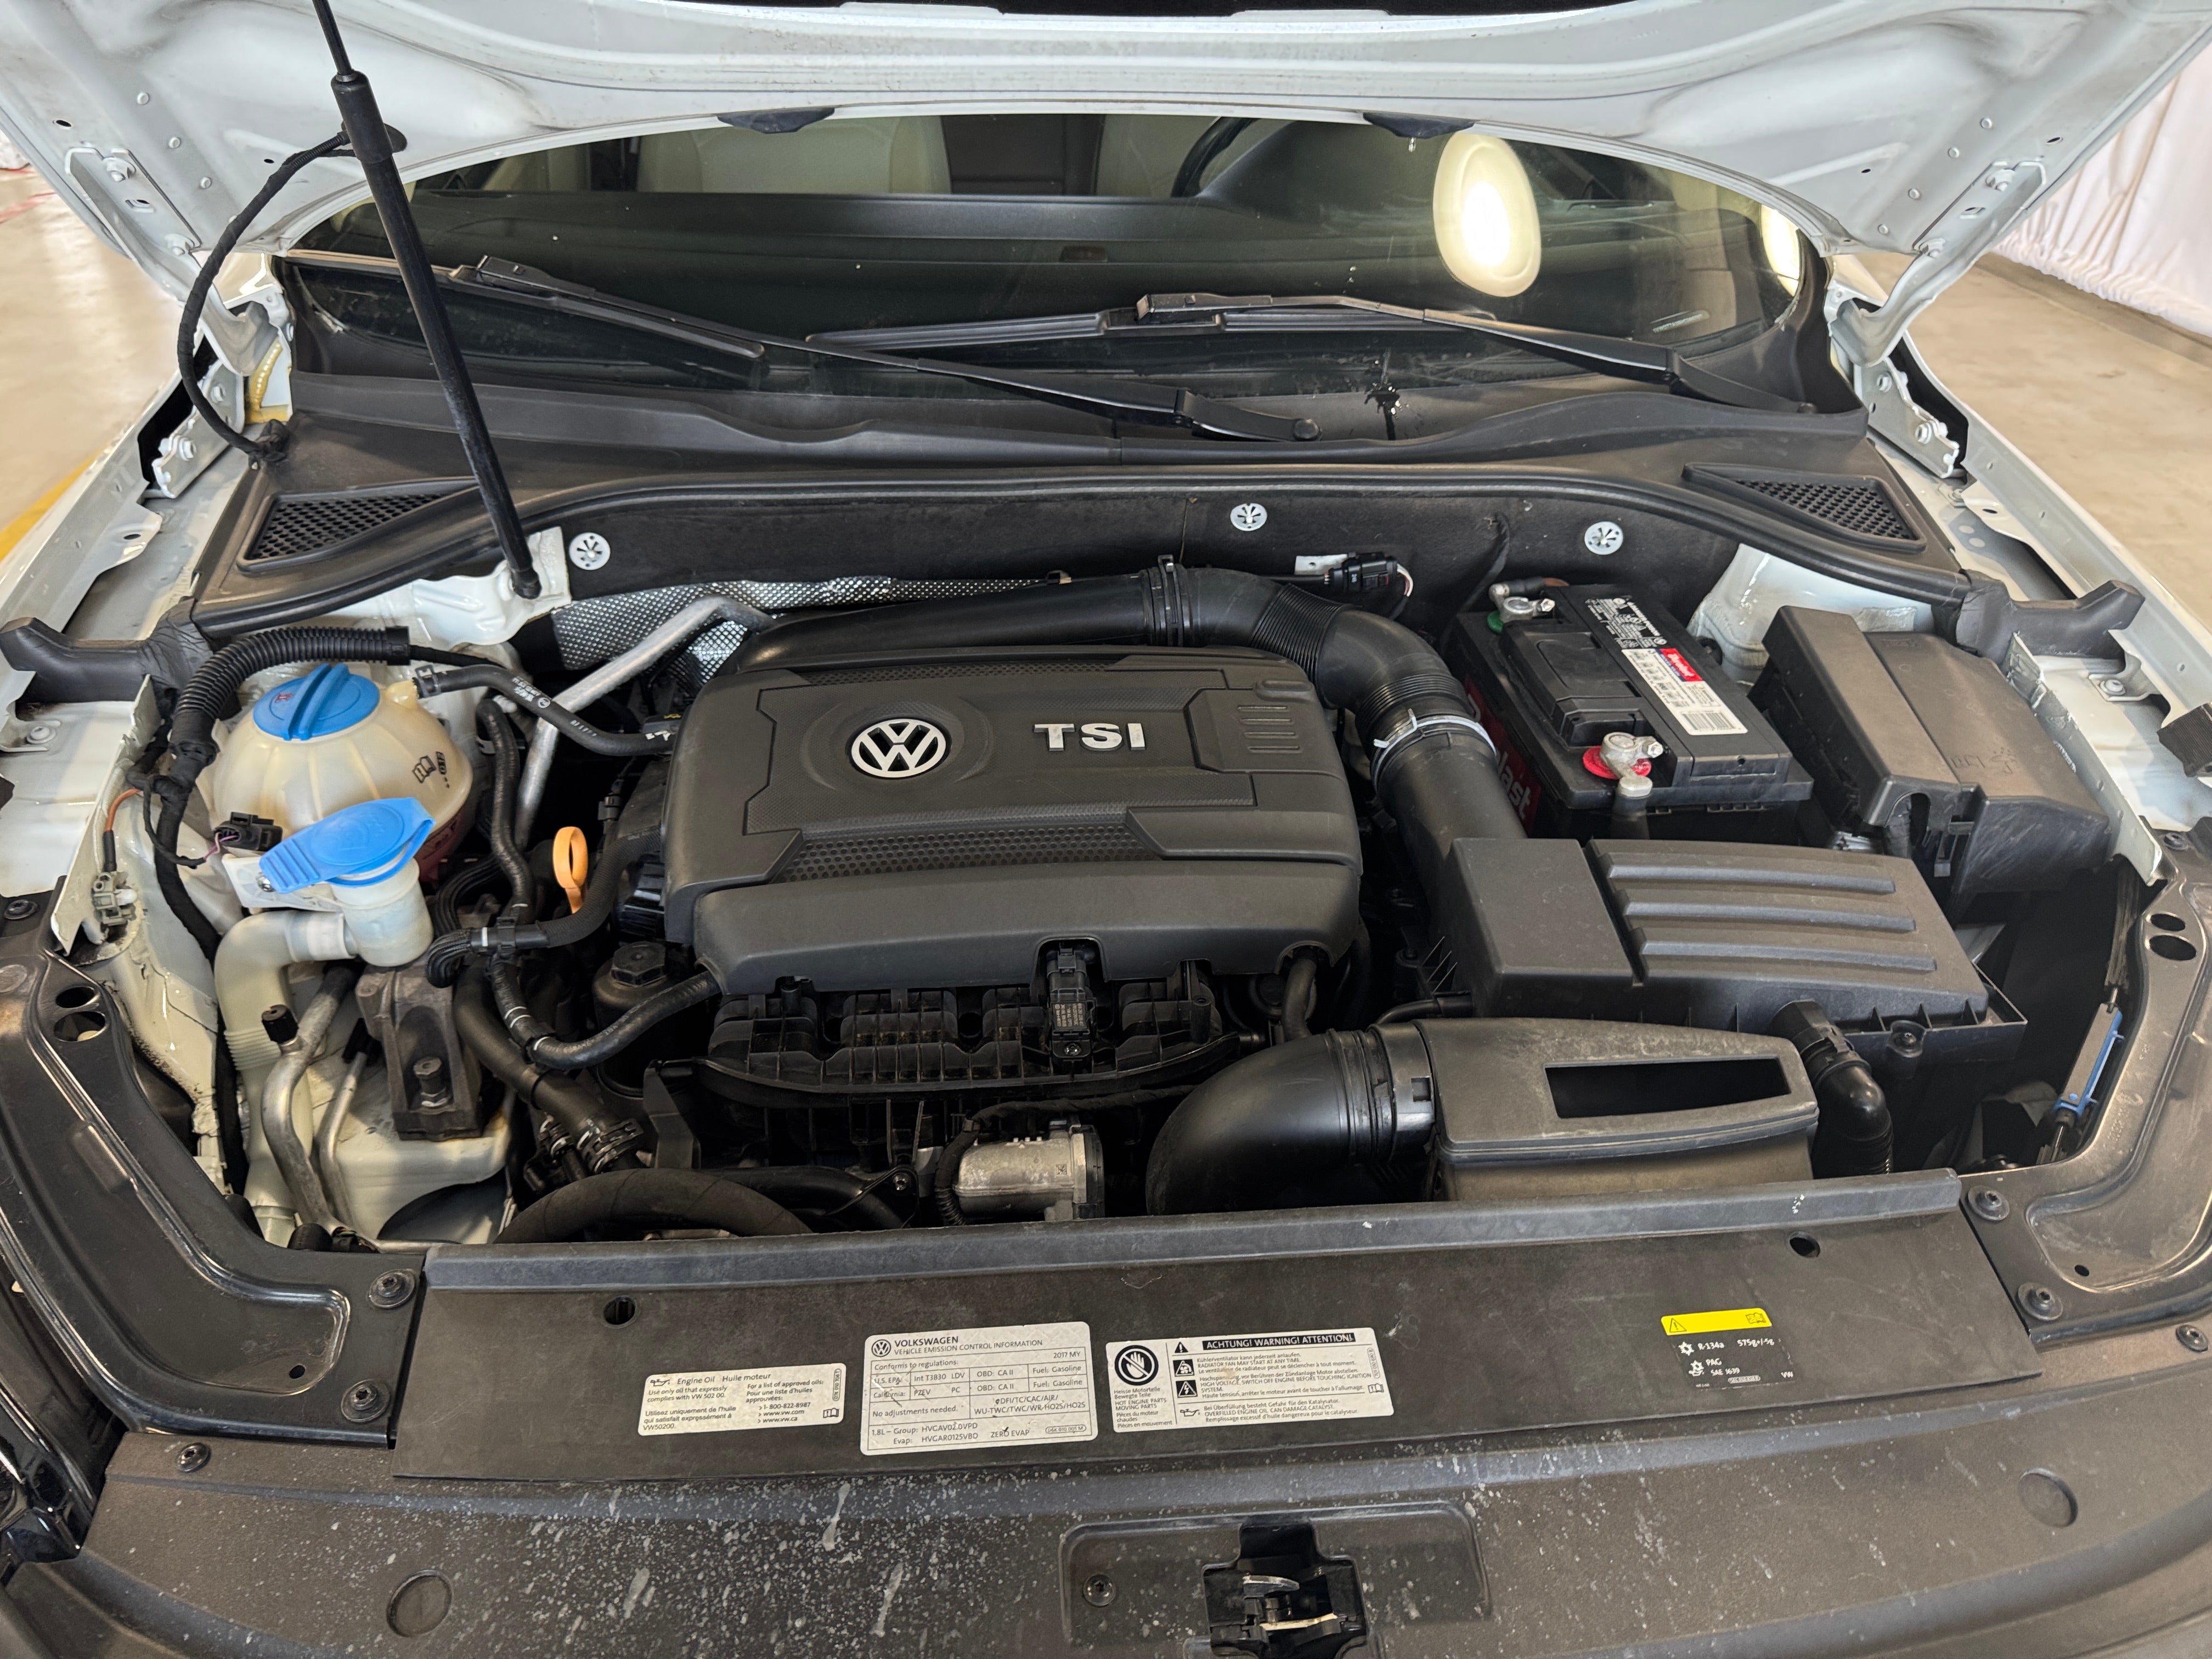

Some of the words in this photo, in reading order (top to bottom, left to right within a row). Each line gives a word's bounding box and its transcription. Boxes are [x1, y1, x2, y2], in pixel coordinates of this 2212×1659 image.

[1033, 723, 1147, 751] TSI
[851, 718, 947, 778] VW
[895, 1336, 958, 1347] VOLKSWAGEN
[994, 1340, 1042, 1348] INFORMATION
[1207, 1339, 1252, 1348] ACHTUNG!
[1254, 1336, 1300, 1346] WARNING!
[1302, 1334, 1353, 1344] ATTENTION!
[918, 1360, 958, 1368] regulations:
[677, 1378, 702, 1386] Engine
[884, 1408, 928, 1417] adjustments
